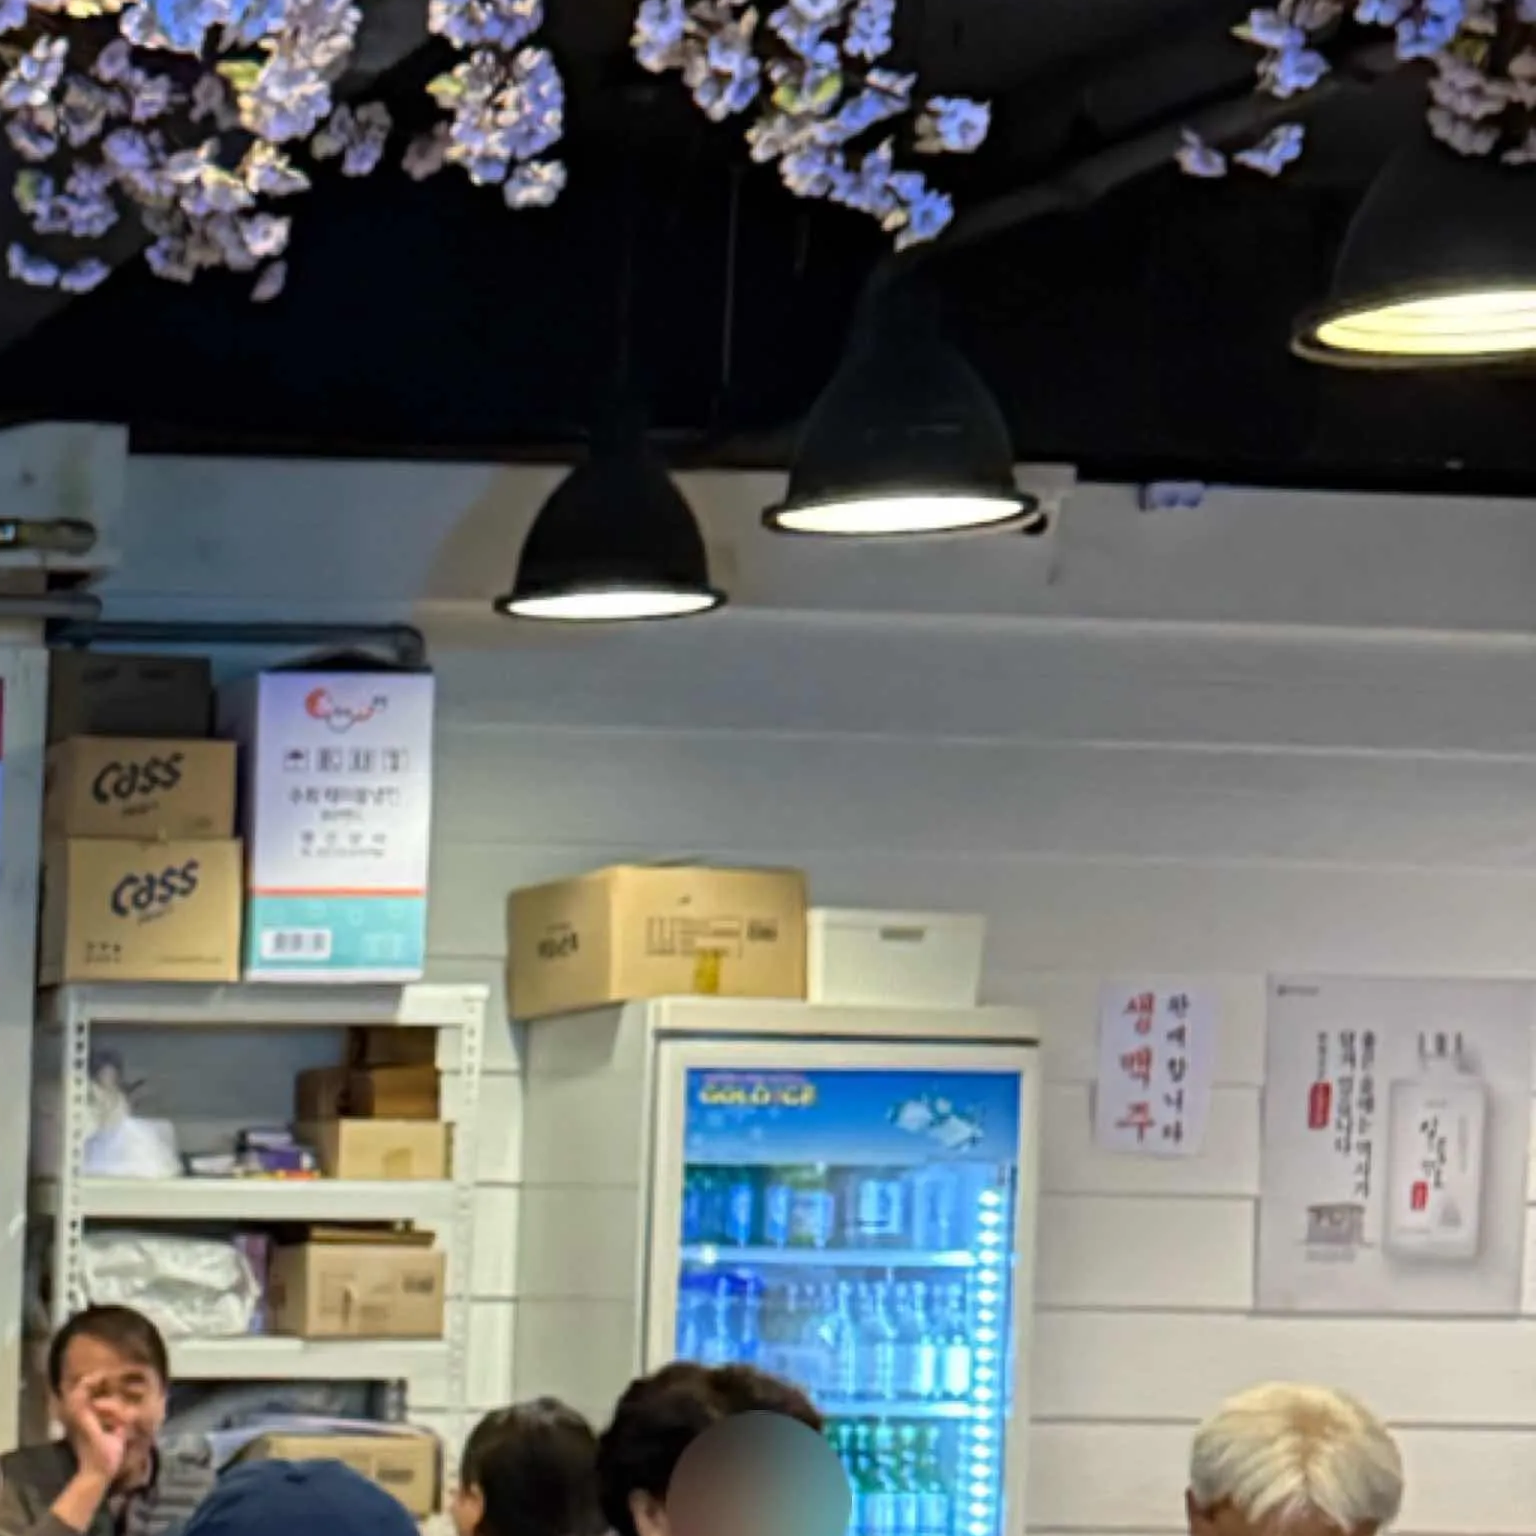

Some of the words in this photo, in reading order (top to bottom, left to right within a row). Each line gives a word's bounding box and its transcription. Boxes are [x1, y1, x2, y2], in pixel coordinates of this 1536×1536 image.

[92, 752, 184, 805] Cass
[111, 859, 199, 918] Cass
[1114, 991, 1157, 1144] 생맥주
